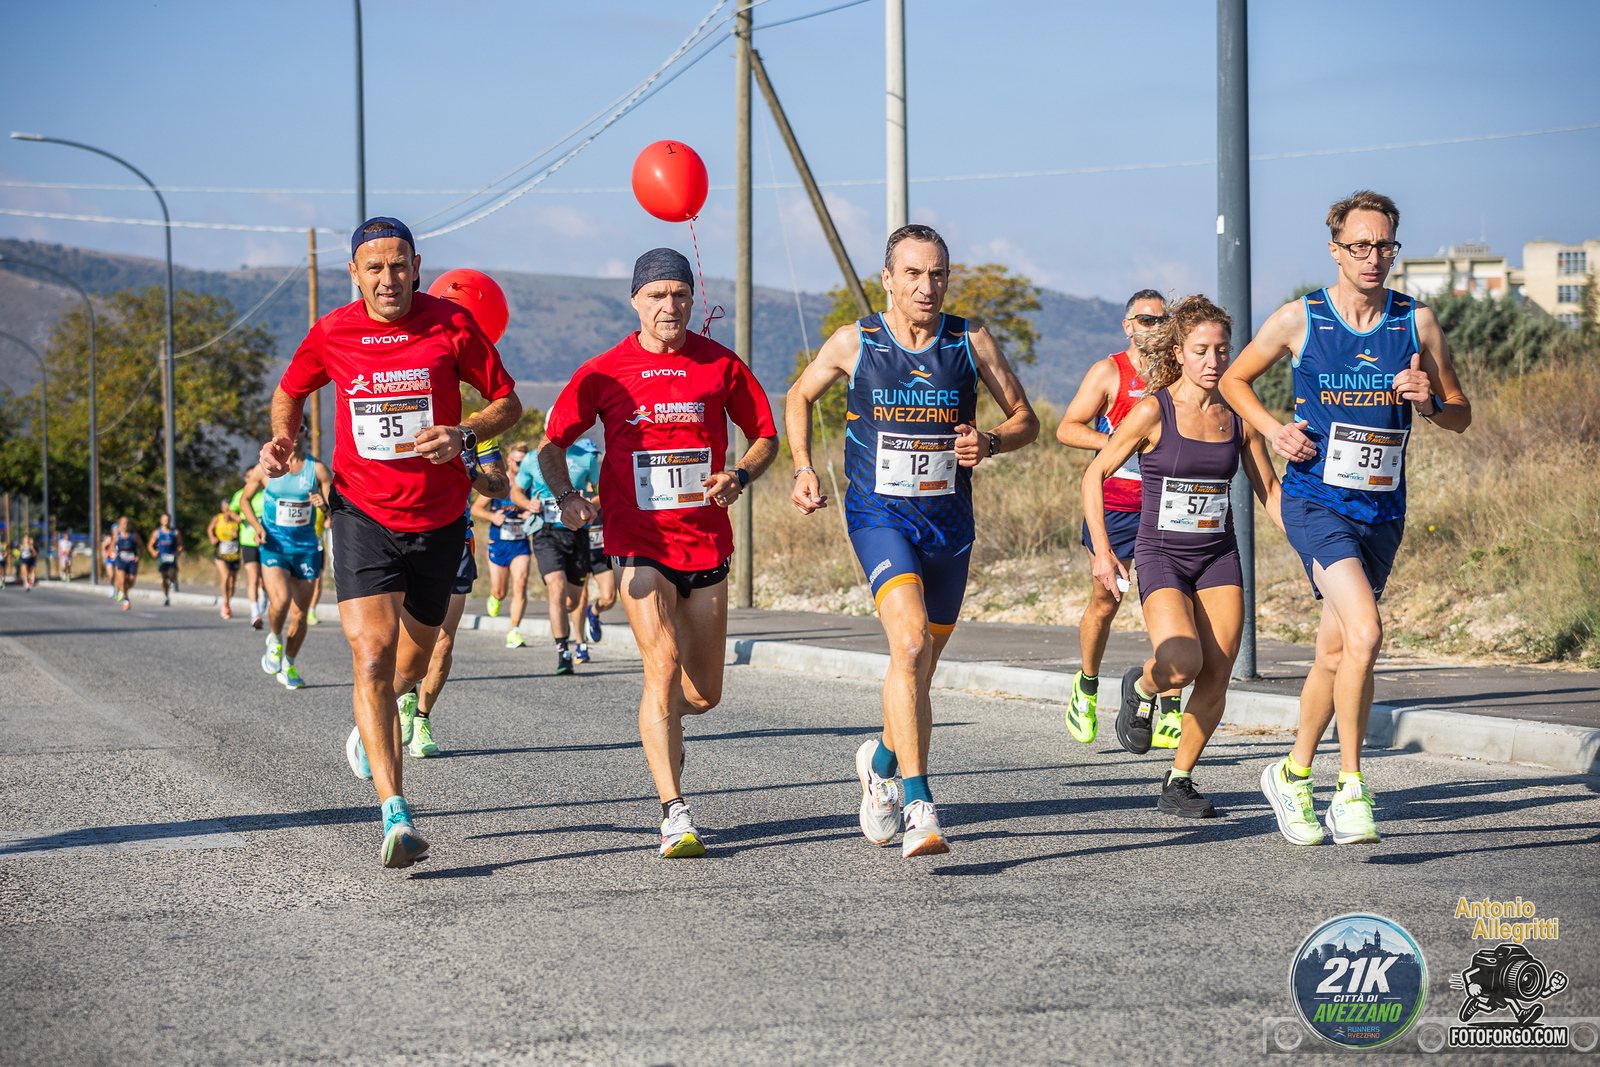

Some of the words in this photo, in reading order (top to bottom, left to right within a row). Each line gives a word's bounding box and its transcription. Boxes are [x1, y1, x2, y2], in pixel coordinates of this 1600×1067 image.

[362, 335, 408, 344] GIVOVA
[372, 368, 429, 383] RUNNERS
[641, 369, 687, 378] GIVOVA
[373, 379, 430, 394] AVEZZANO
[1318, 374, 1395, 389] RUNNER
[872, 389, 960, 406] RUNNERS
[365, 403, 383, 413] 21K
[654, 402, 705, 413] RUNNERS
[873, 407, 958, 423] AVEZZANO
[654, 413, 705, 423] AVEZZANO
[379, 416, 404, 438] 35
[1347, 431, 1368, 441] 21K
[894, 439, 914, 450] 21K
[650, 455, 667, 465] 21K
[910, 454, 930, 475] 12
[1358, 446, 1383, 469] 33
[667, 468, 683, 488] 11
[1177, 483, 1194, 492] 21K
[1187, 496, 1209, 514] 57
